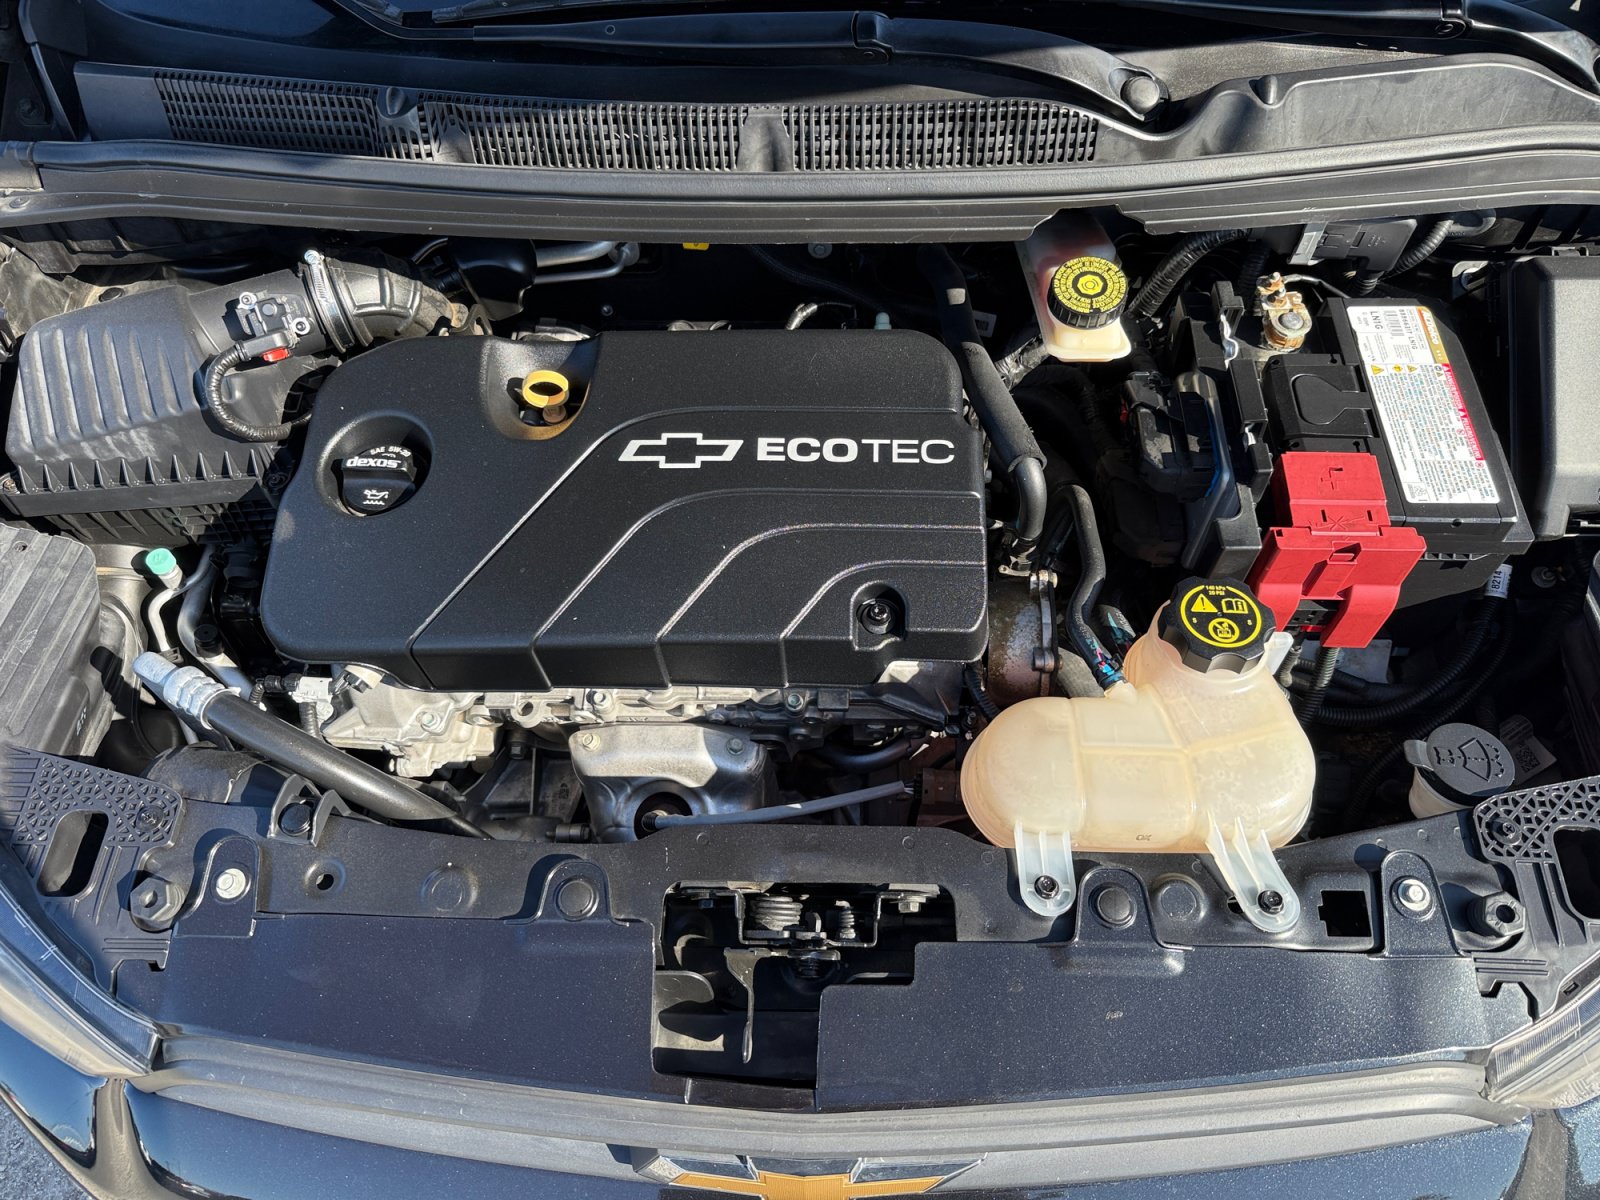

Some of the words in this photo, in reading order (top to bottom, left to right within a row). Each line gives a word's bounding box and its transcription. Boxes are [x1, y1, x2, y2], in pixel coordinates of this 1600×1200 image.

[1371, 311, 1383, 329] LN1G
[370, 446, 385, 455] SAE
[757, 437, 955, 464] ECOTEC
[346, 456, 401, 468] dexos
